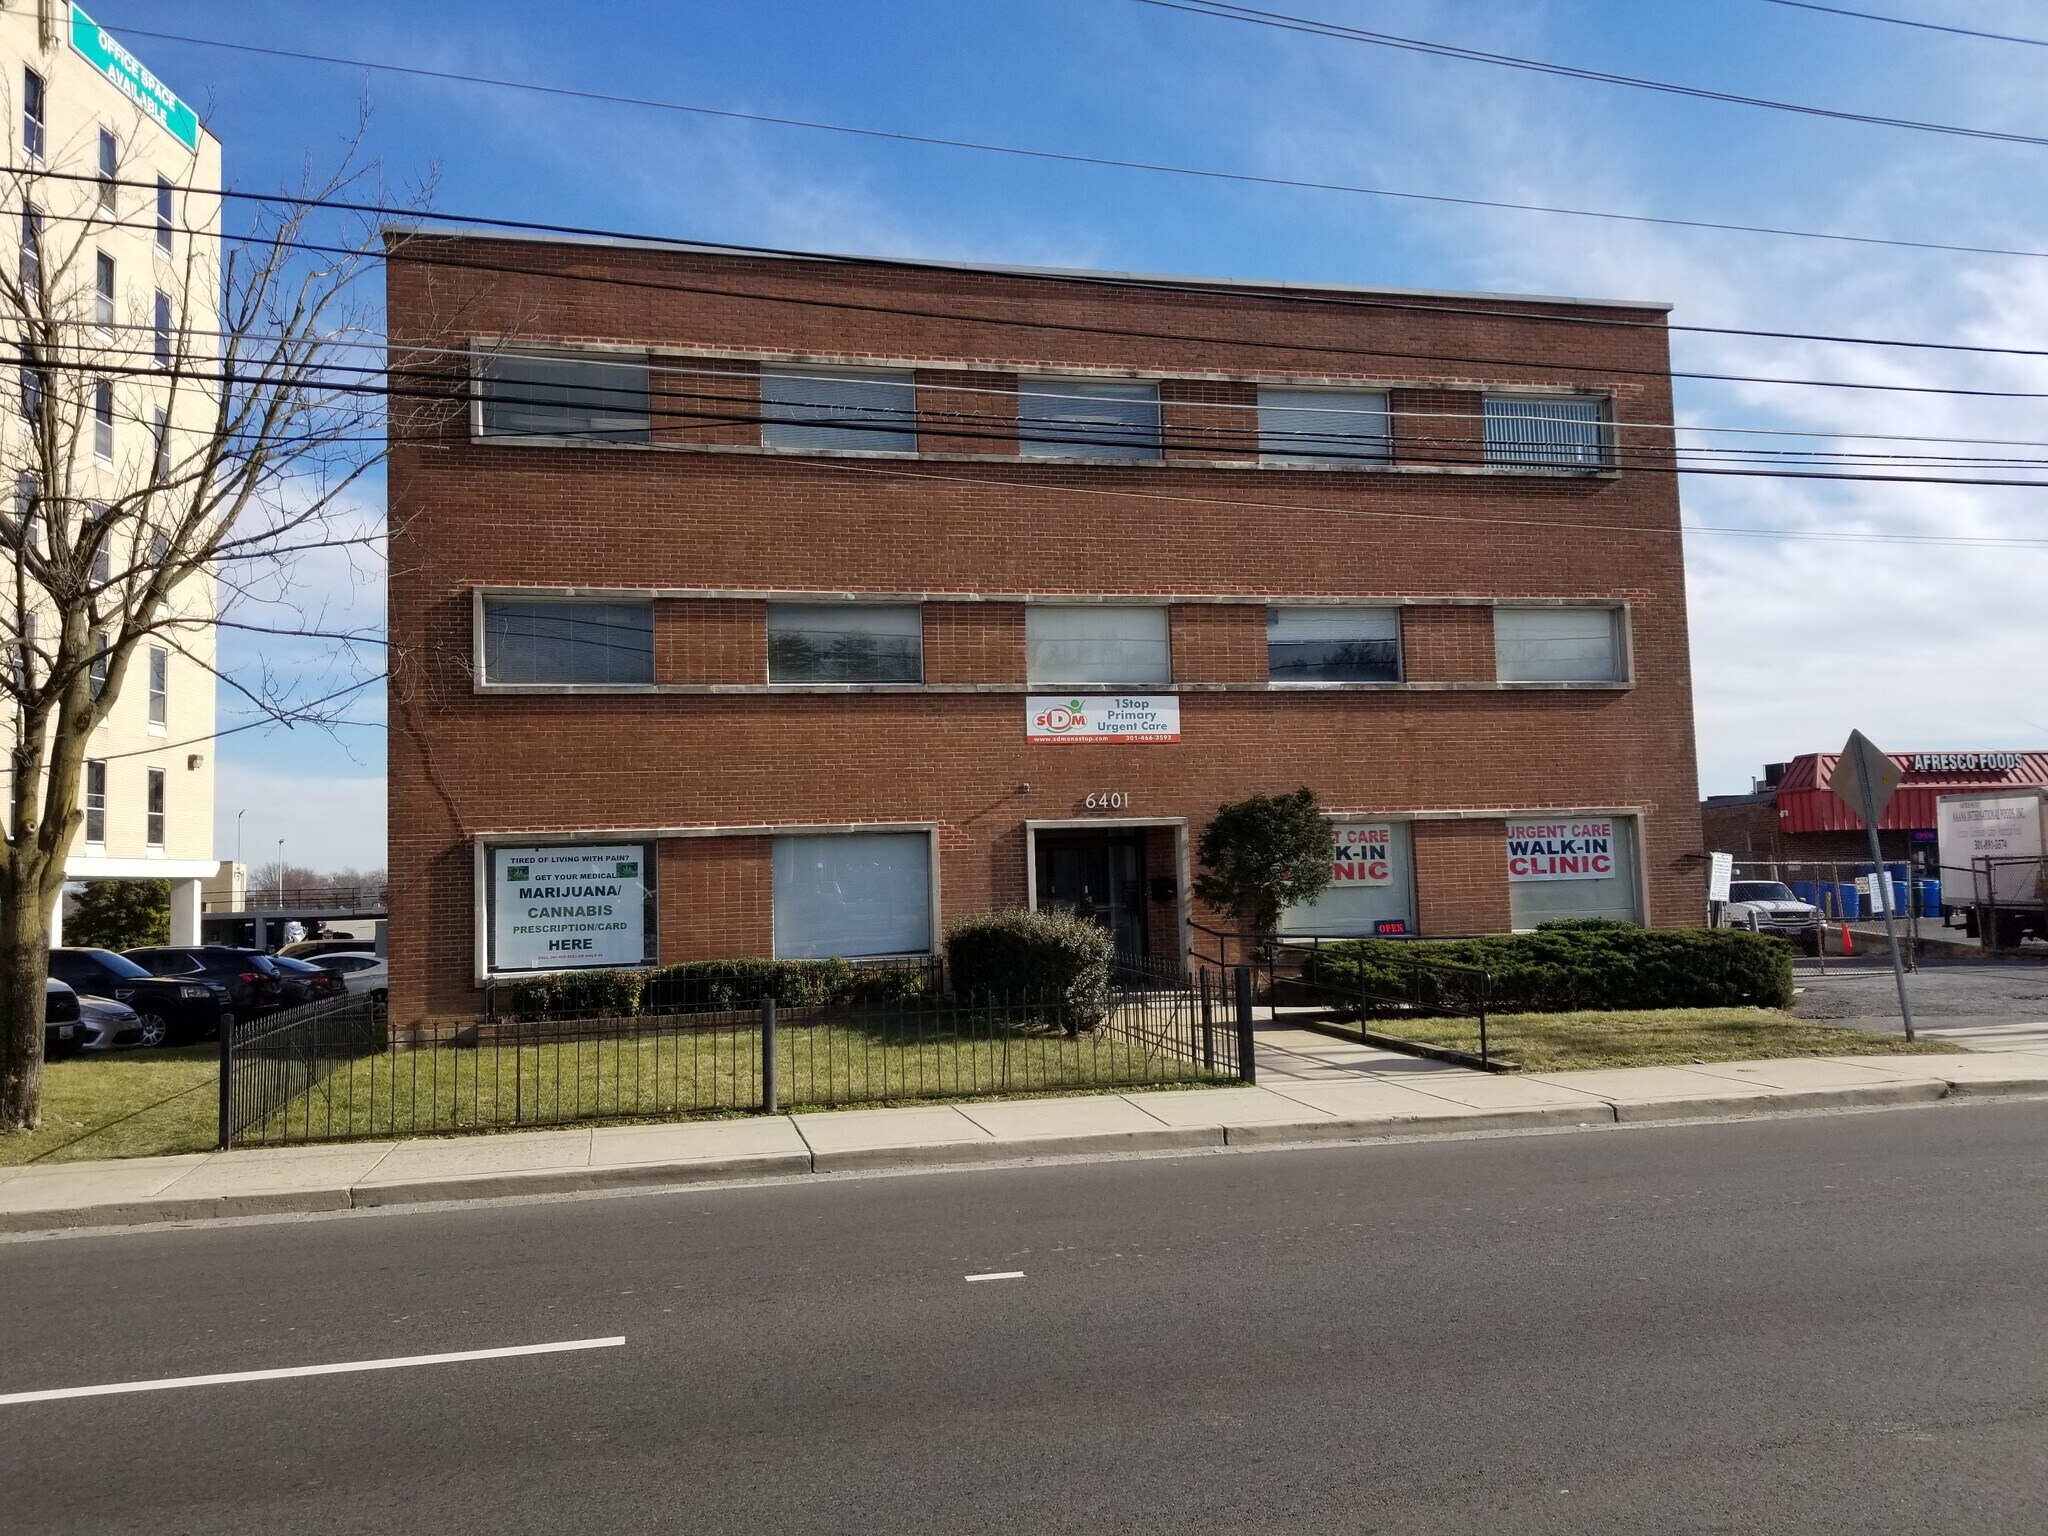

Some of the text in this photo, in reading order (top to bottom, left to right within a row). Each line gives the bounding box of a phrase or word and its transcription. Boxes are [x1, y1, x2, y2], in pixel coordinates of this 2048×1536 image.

[98, 31, 176, 112] OFFICE SPACE
[107, 63, 168, 126] AVAILABLE
[1037, 708, 1086, 729] SDM
[1107, 710, 1157, 722] Primary
[1097, 721, 1168, 733] Urgent Care
[1033, 735, 1109, 743] www.sdmonestop.com
[1914, 753, 2023, 770] AFRESCO FOODS
[1085, 792, 1129, 809] 6401
[1347, 829, 1389, 843] CARE
[1506, 824, 1611, 839] URGENT CARE
[1508, 839, 1608, 855] WALK-IN
[1509, 855, 1611, 875] CLINIC
[580, 872, 616, 880] MEDICAL
[519, 885, 622, 899] MARIJUANA/
[527, 905, 613, 918] CANNABIS
[513, 922, 627, 934] PRESCRIPTION/CARD
[1378, 923, 1404, 932] OPEN
[549, 938, 593, 950] HERE
